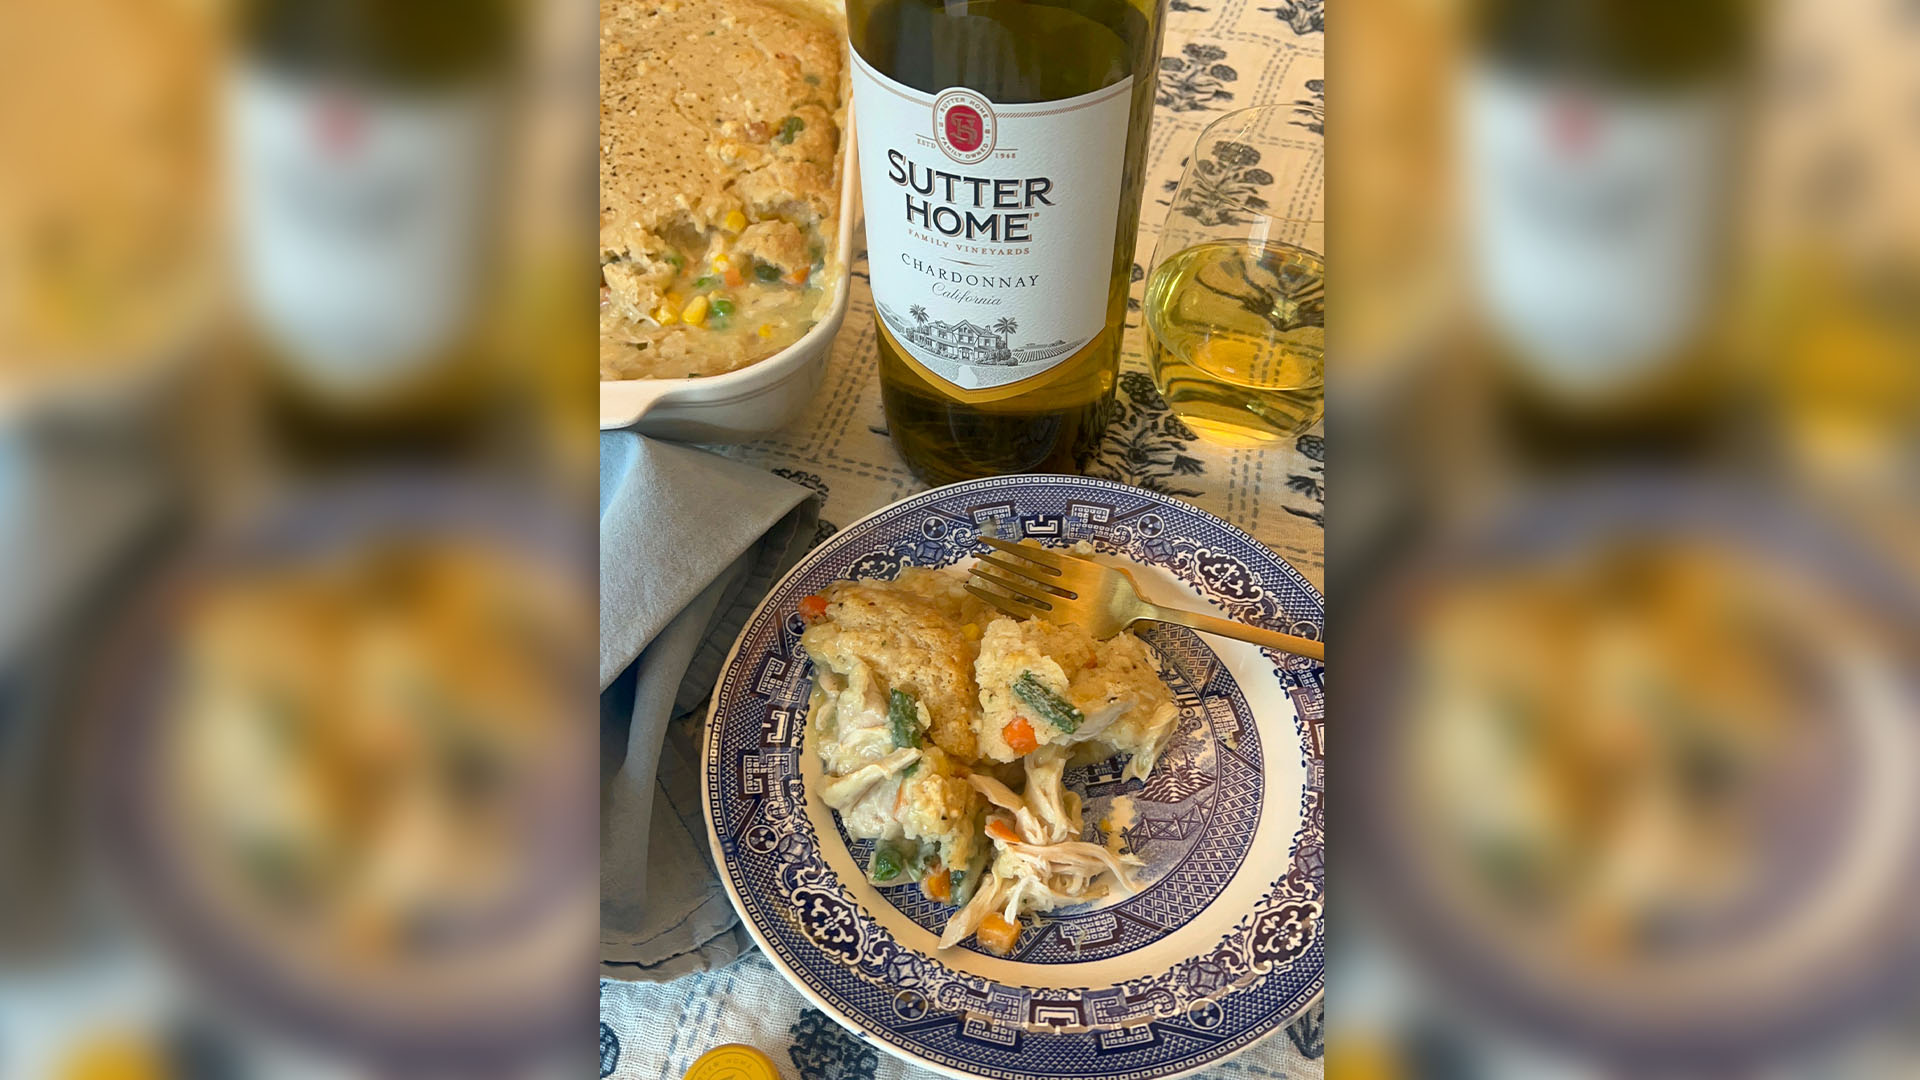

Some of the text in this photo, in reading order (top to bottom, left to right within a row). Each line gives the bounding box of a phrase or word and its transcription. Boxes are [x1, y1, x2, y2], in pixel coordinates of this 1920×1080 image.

[940, 97, 989, 119] SUTTER HOME
[941, 136, 989, 159] FAMILY OWNED
[888, 149, 1056, 209] SUTTER
[906, 193, 1033, 243] HOME
[908, 228, 1030, 255] FAMILY VINEYARDS
[901, 252, 1039, 288] CHARDONNAY
[931, 281, 1003, 305] California
